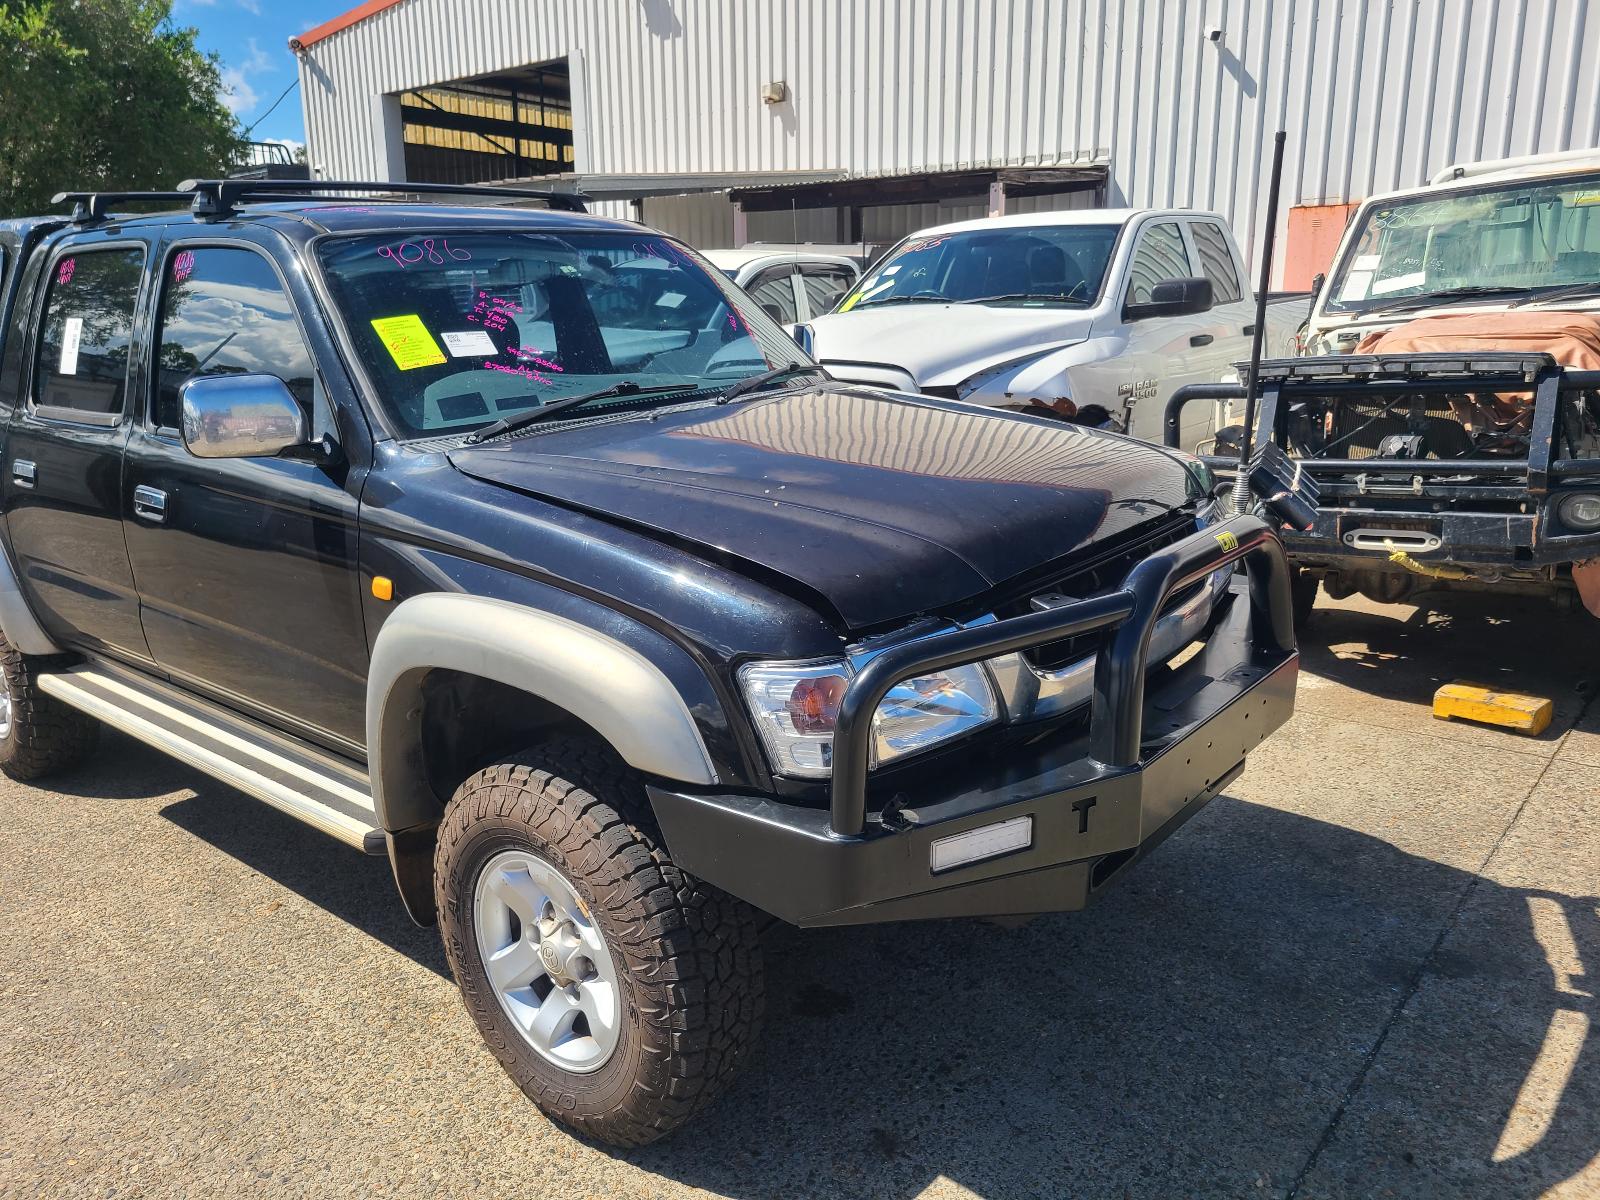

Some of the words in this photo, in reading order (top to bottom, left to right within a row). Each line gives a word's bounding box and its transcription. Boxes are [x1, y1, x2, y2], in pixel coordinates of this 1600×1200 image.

[377, 239, 472, 270] 9086
[466, 314, 480, 322] C-
[484, 319, 506, 332] 204
[515, 1066, 578, 1111] OPEN
